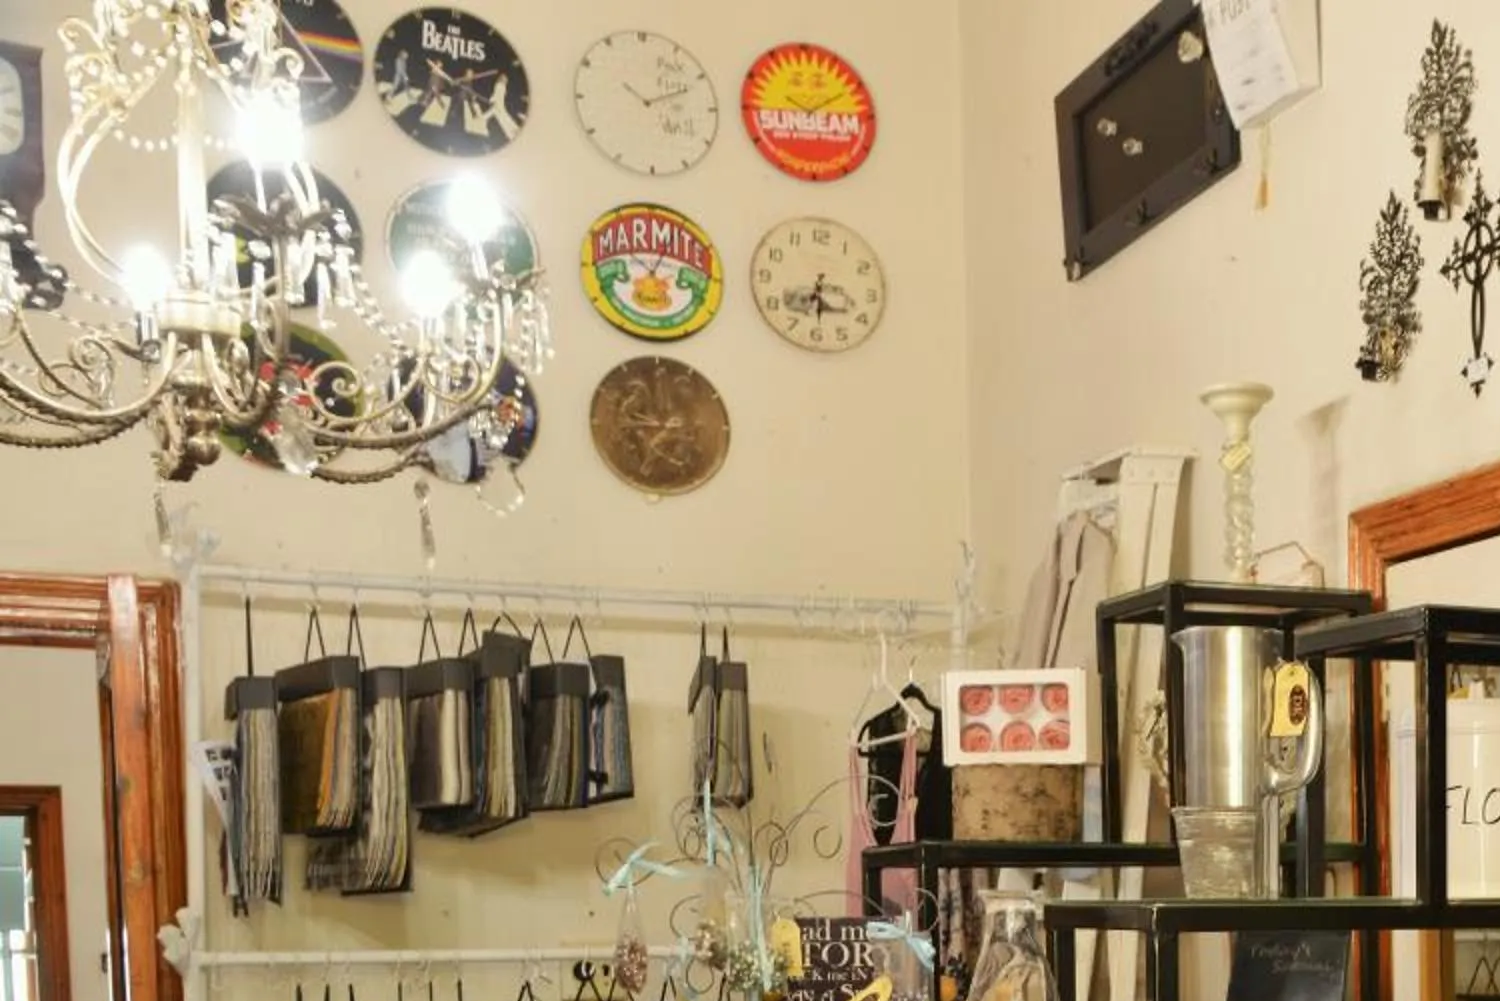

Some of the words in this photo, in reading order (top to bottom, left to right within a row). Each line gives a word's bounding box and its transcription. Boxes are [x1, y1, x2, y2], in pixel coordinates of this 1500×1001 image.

[421, 19, 487, 62] BEATLES
[759, 108, 860, 135] SUNBEAM
[598, 217, 704, 269] MARMITE
[811, 227, 831, 246] 12
[768, 245, 784, 263] 10
[856, 259, 872, 276] 2
[865, 287, 878, 304] 3
[786, 316, 800, 332] 7
[854, 312, 869, 326] 4
[809, 326, 824, 342] 6
[835, 326, 849, 342] 5
[801, 918, 832, 941] ad
[801, 942, 875, 967] TOR
